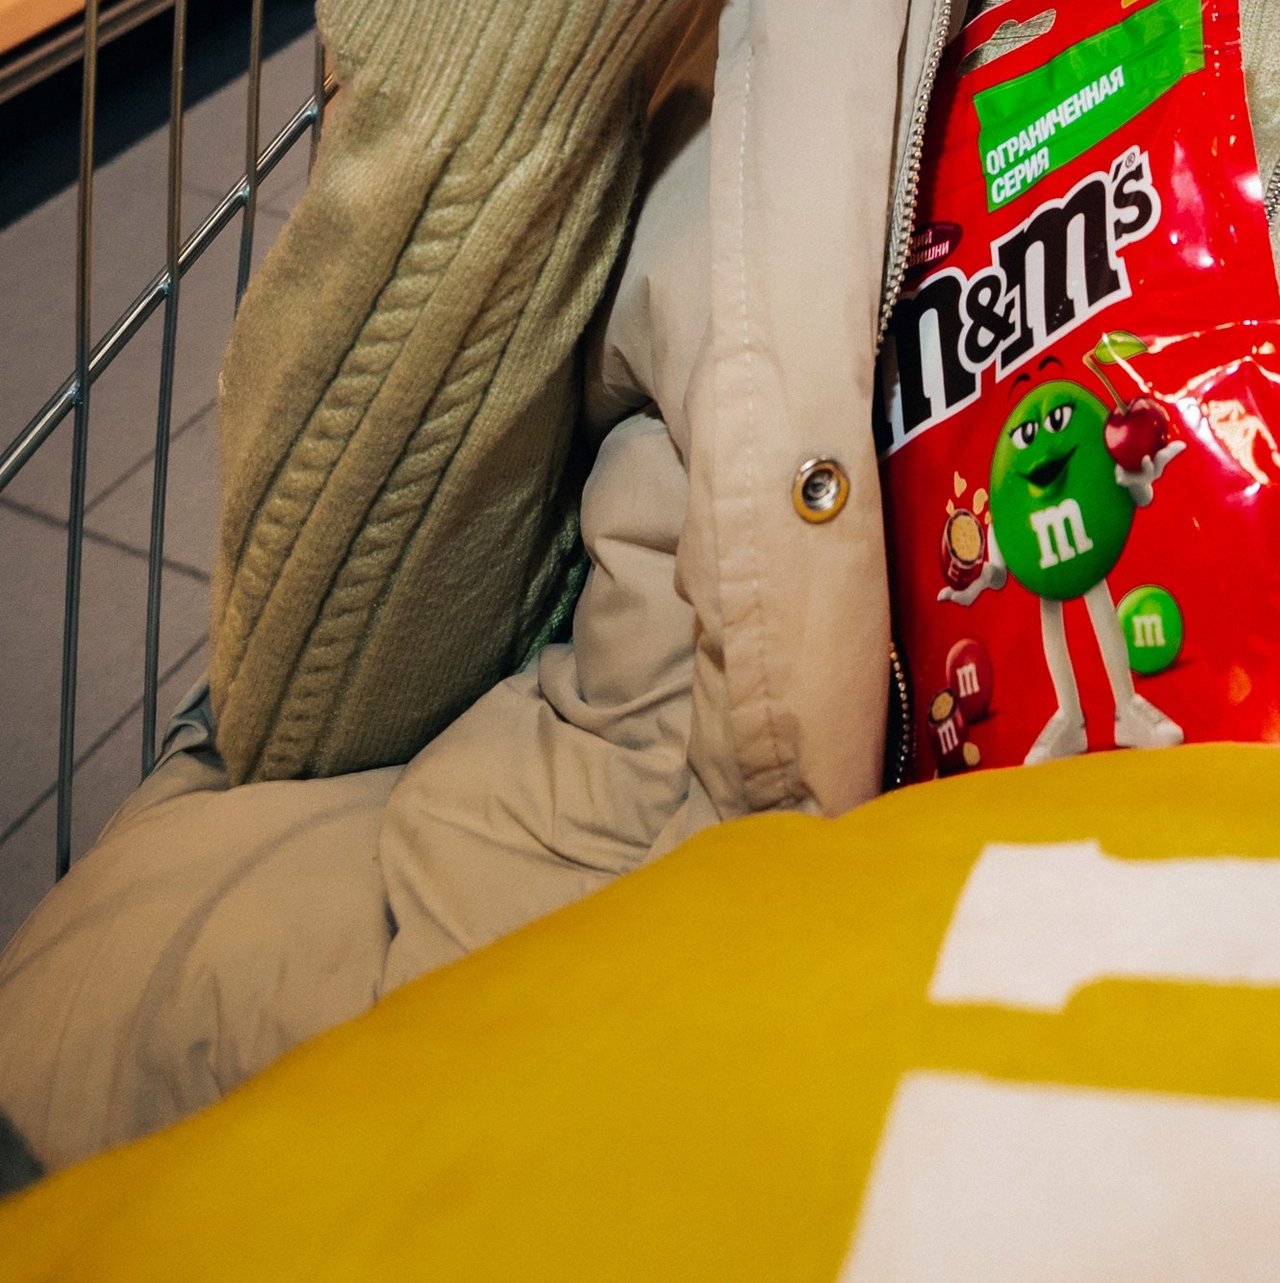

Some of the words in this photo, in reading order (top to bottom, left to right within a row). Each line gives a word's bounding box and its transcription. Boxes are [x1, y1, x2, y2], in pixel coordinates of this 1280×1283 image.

[986, 65, 1126, 175] ОГРАНИЧЕННАЯ
[991, 146, 1050, 204] СЕРИЯ
[1030, 498, 1094, 569] m
[1132, 614, 1166, 647] m
[956, 663, 980, 698] m
[936, 719, 959, 755] m
